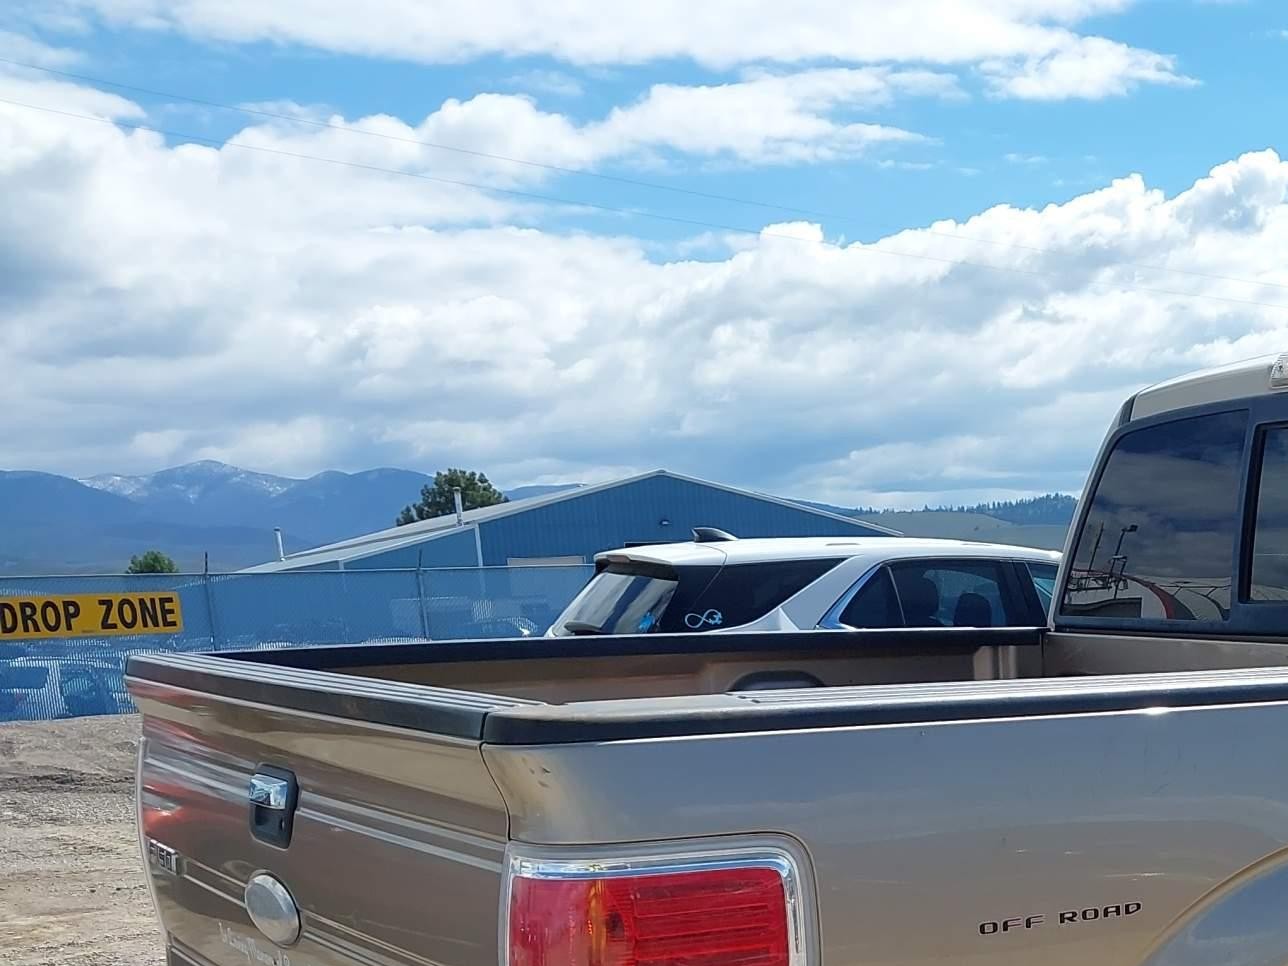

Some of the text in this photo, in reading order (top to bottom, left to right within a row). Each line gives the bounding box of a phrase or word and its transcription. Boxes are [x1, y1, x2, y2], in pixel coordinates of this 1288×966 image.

[0, 596, 178, 634] DROP ZONE
[979, 902, 1142, 935] OFF ROAD
